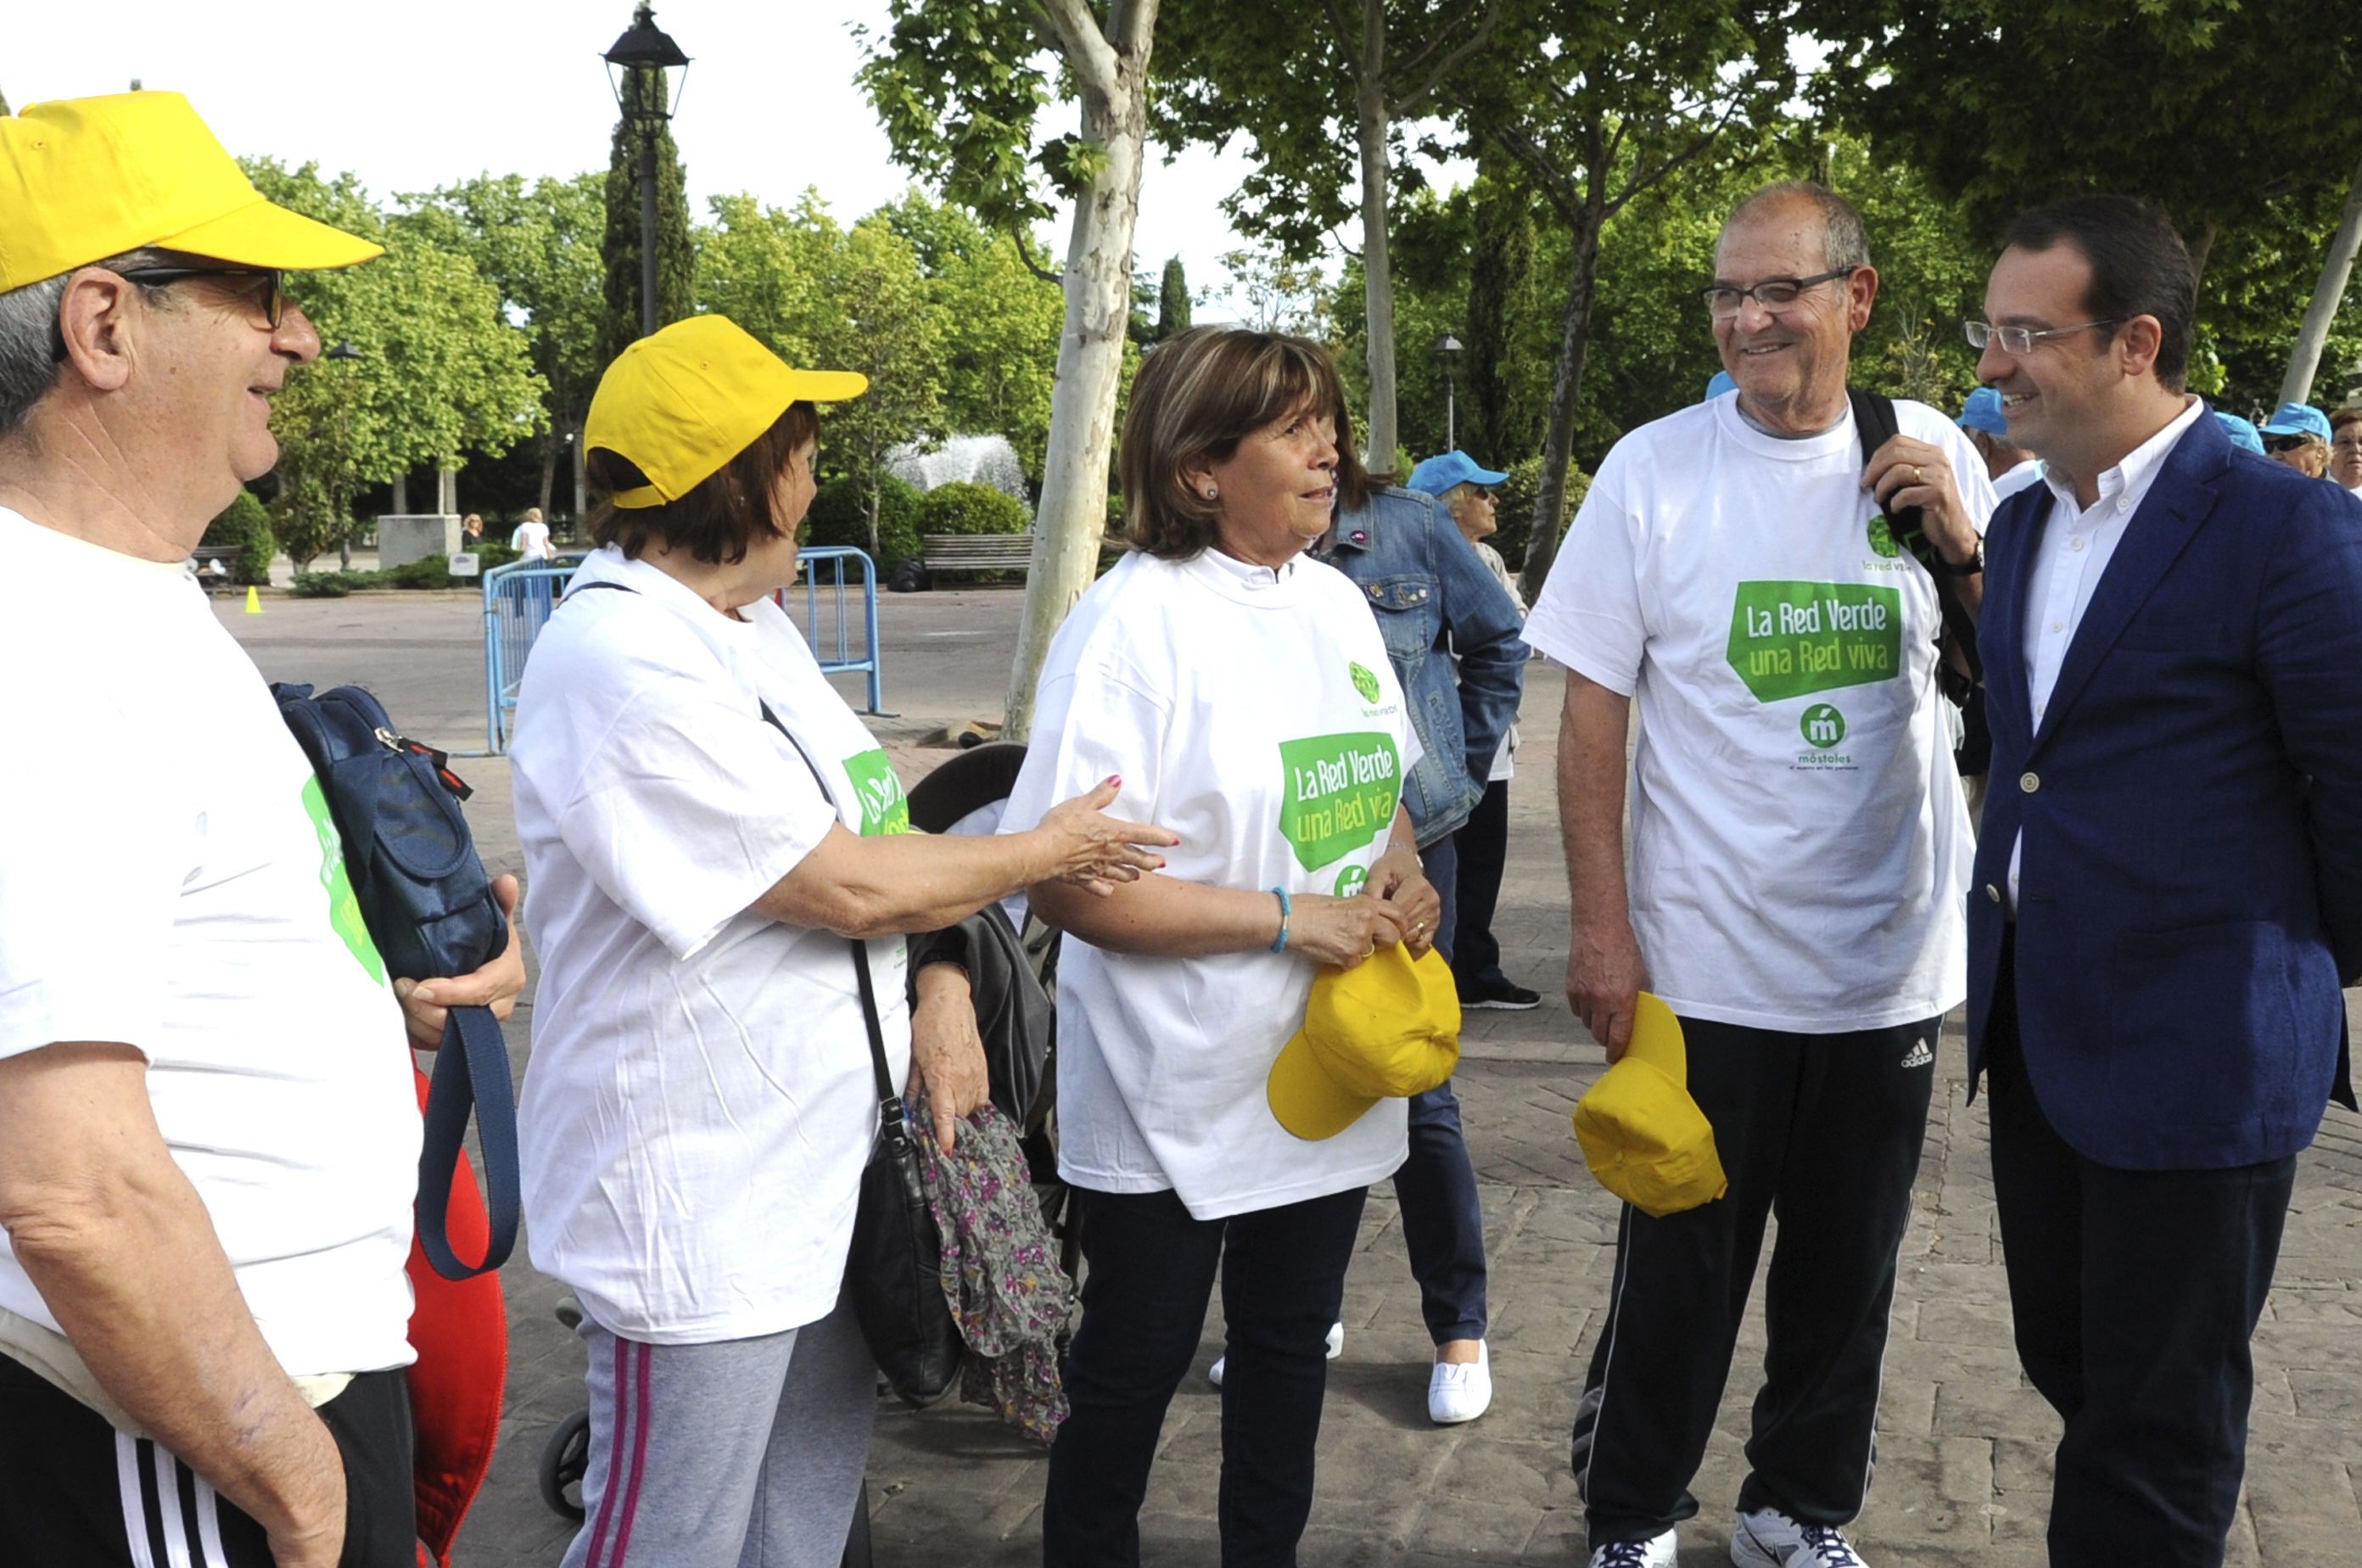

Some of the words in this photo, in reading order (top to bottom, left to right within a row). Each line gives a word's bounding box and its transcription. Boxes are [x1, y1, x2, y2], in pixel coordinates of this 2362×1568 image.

[1747, 606, 1772, 638] La
[1779, 600, 1820, 635] Red
[1826, 597, 1886, 631] Verde
[1750, 647, 1791, 675] una
[1799, 637, 1840, 673] Red
[1847, 637, 1888, 669] viva
[1296, 767, 1319, 802] La
[1317, 753, 1348, 797] Red
[1348, 744, 1394, 785] Verde
[1798, 753, 1851, 764] móstoles
[1297, 809, 1331, 842] una
[1335, 792, 1365, 833] Red
